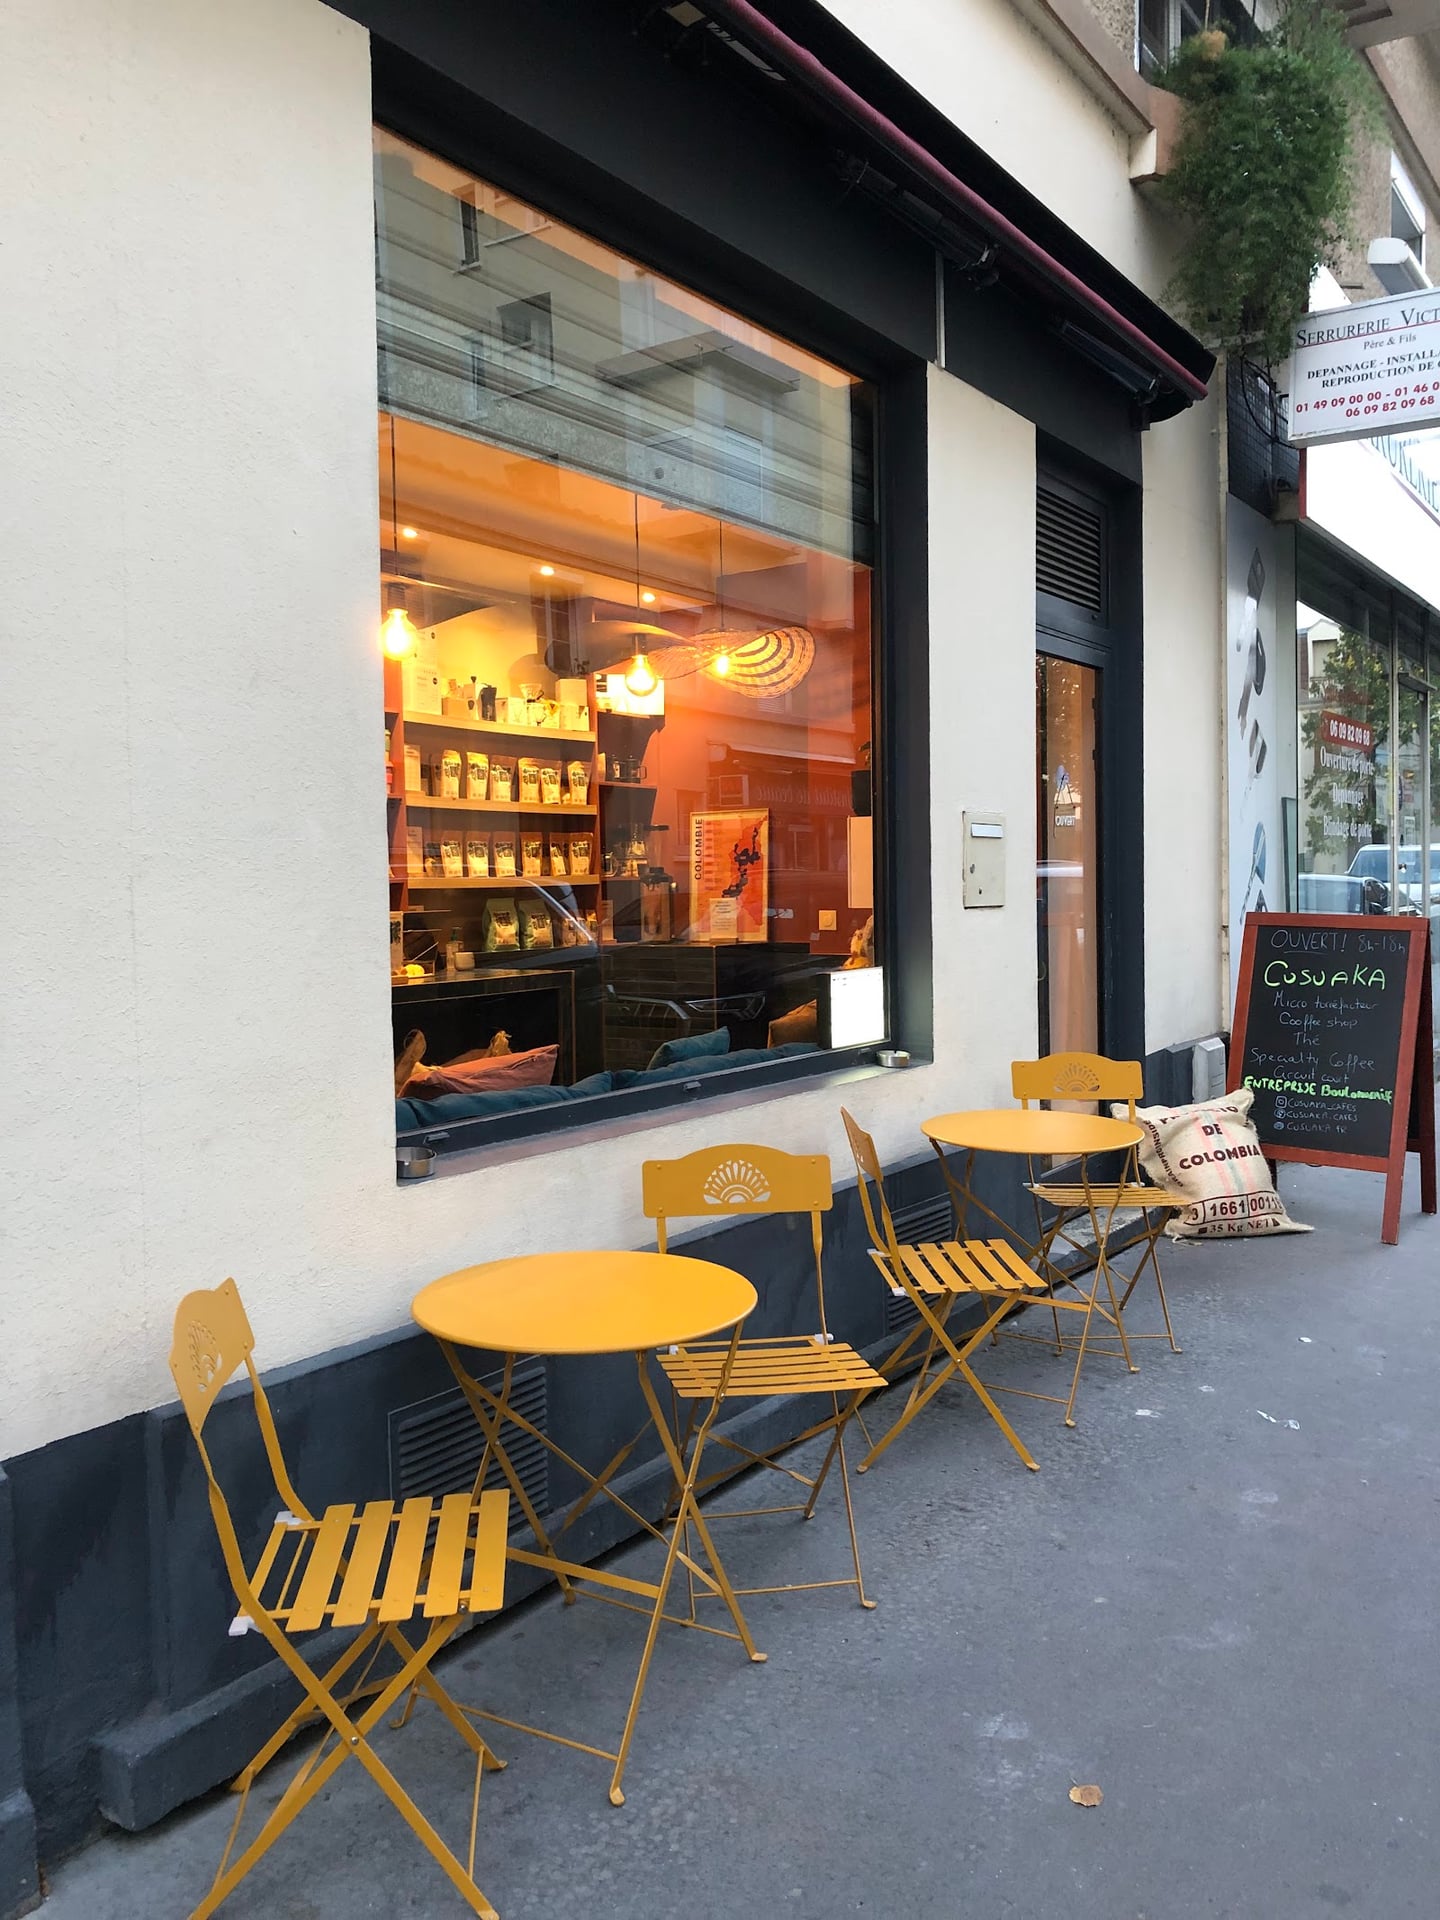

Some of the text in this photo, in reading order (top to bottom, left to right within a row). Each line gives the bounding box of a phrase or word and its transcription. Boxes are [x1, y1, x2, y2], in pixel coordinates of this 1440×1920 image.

[1296, 318, 1390, 346] SERRURERIE
[1386, 336, 1396, 346] &
[1399, 333, 1417, 344] Fils
[1307, 359, 1377, 379] DEPANNAGE
[1322, 364, 1415, 388] REPRODUCTION
[1418, 361, 1435, 371] DE
[1296, 403, 1309, 413] 01
[1313, 400, 1327, 410] 49
[1331, 397, 1345, 408] 09
[1349, 394, 1363, 405] 00
[1367, 391, 1382, 402] 00
[1394, 386, 1408, 397] 01
[1413, 383, 1428, 393] 46
[1345, 395, 1435, 418] 06 09 82 09 68
[694, 818, 703, 881] COLOMBIE
[1274, 990, 1308, 1009] Micro
[1326, 1017, 1358, 1028] shop
[1249, 1048, 1376, 1072] Specialty Coffee
[1201, 1123, 1223, 1137] DE
[1179, 1144, 1261, 1170] COLOMBIA
[1210, 1199, 1245, 1217] 1661
[1209, 1224, 1224, 1233] 35
